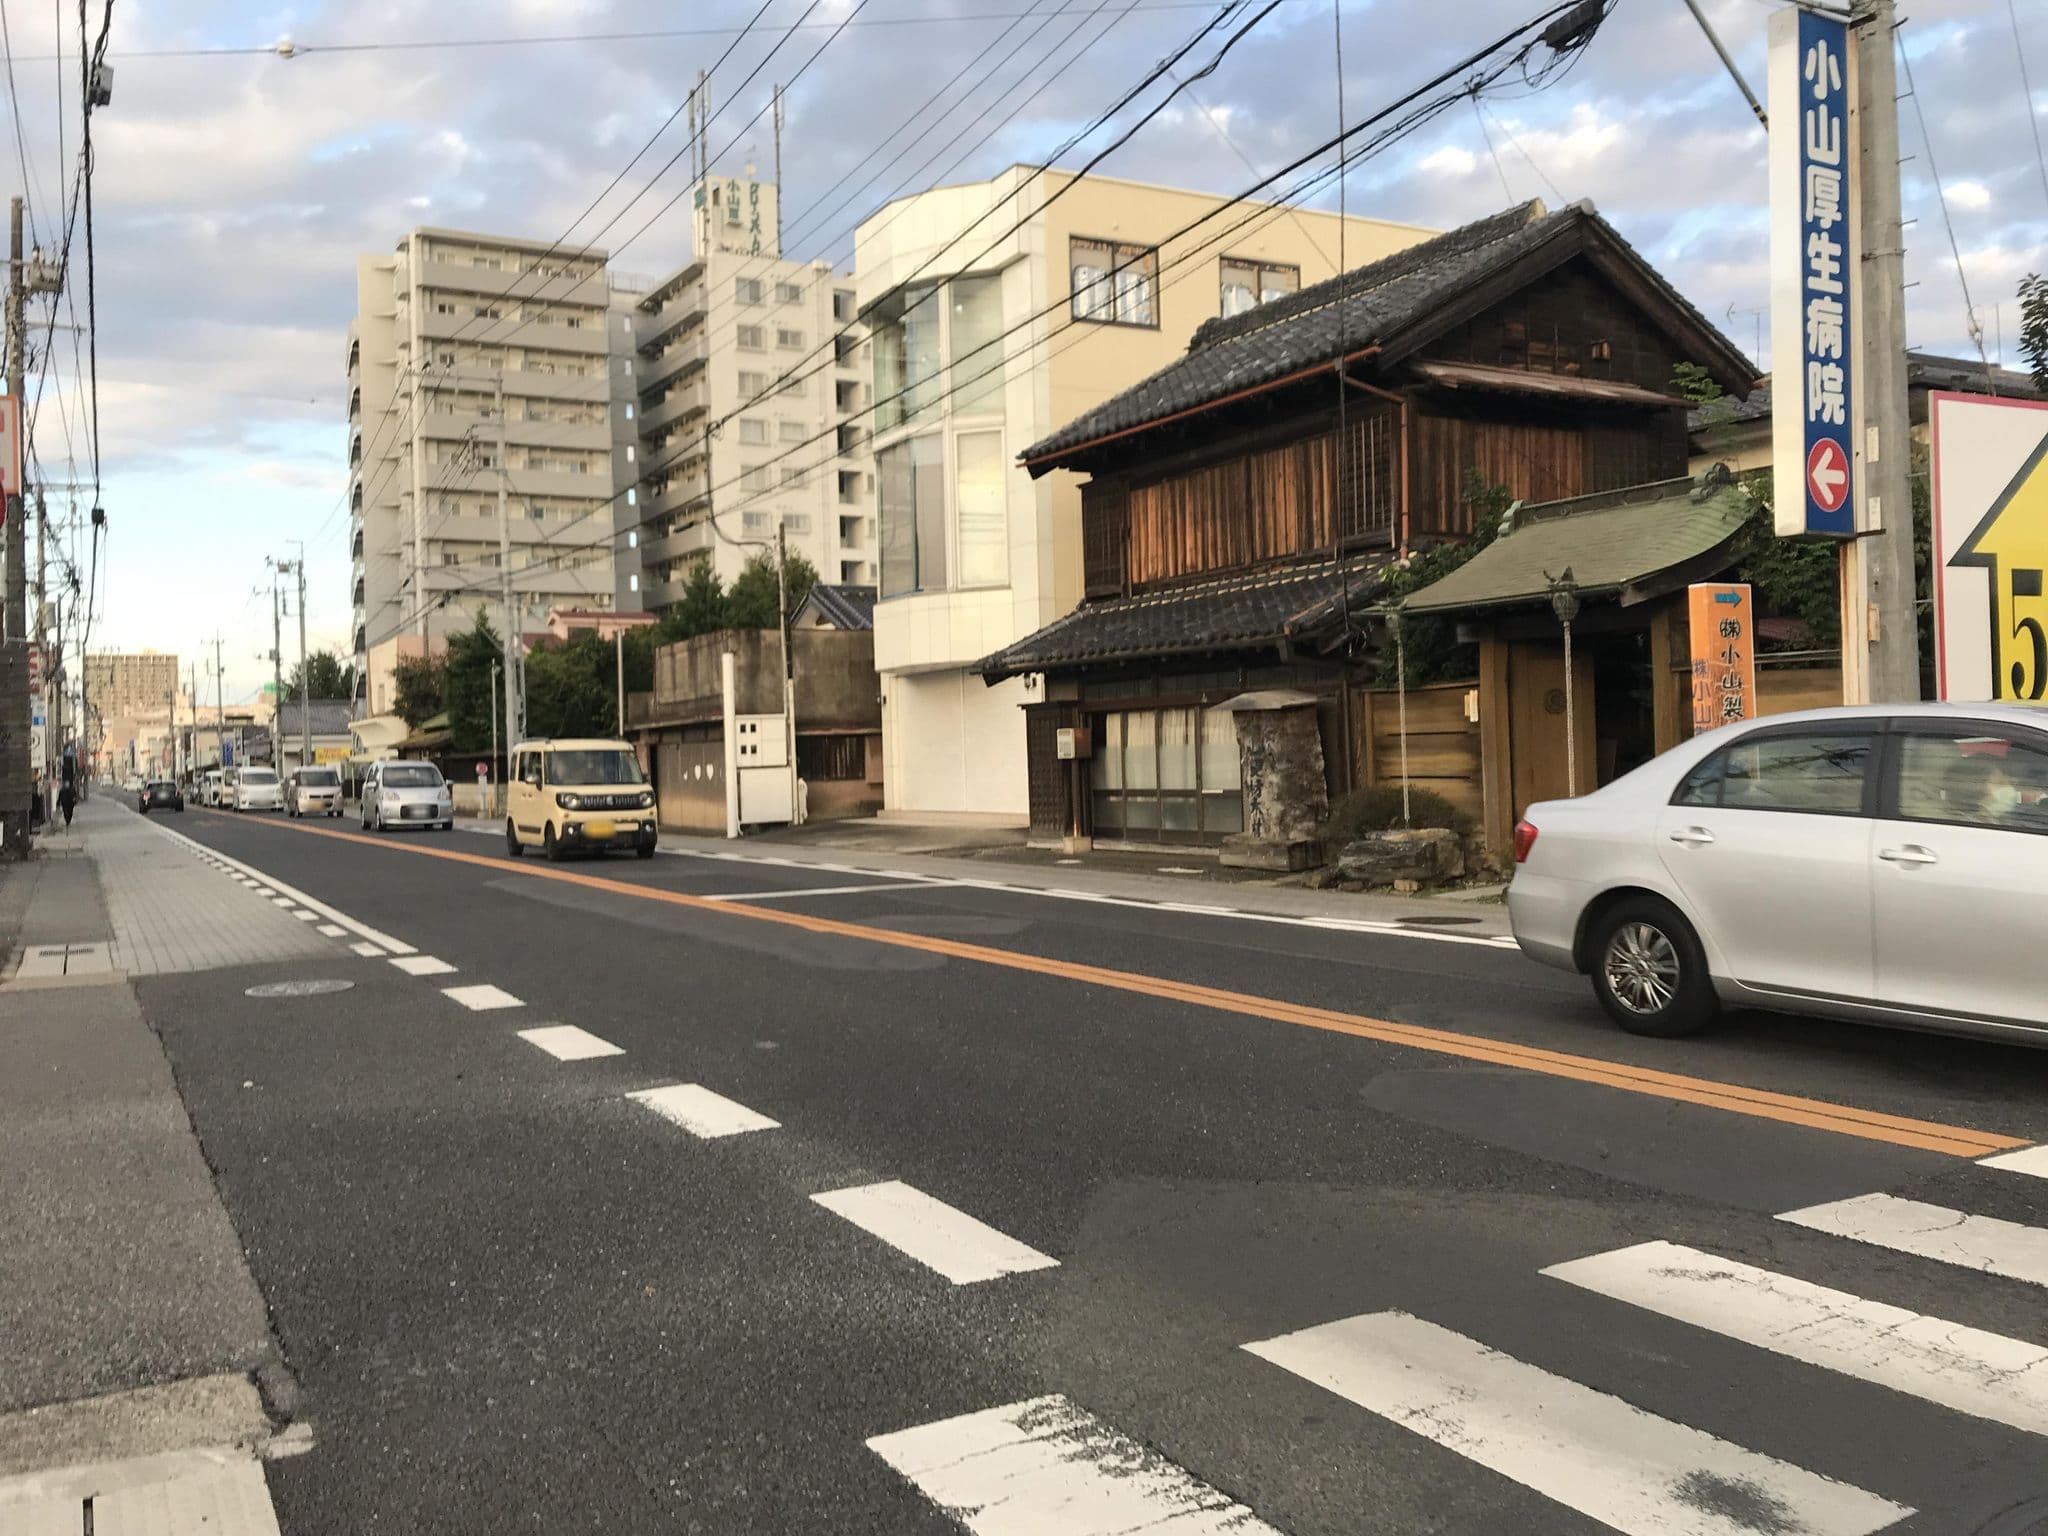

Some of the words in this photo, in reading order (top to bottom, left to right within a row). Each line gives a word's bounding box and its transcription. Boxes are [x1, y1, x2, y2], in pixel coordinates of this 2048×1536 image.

[1803, 38, 1845, 426] 小山厚生病院
